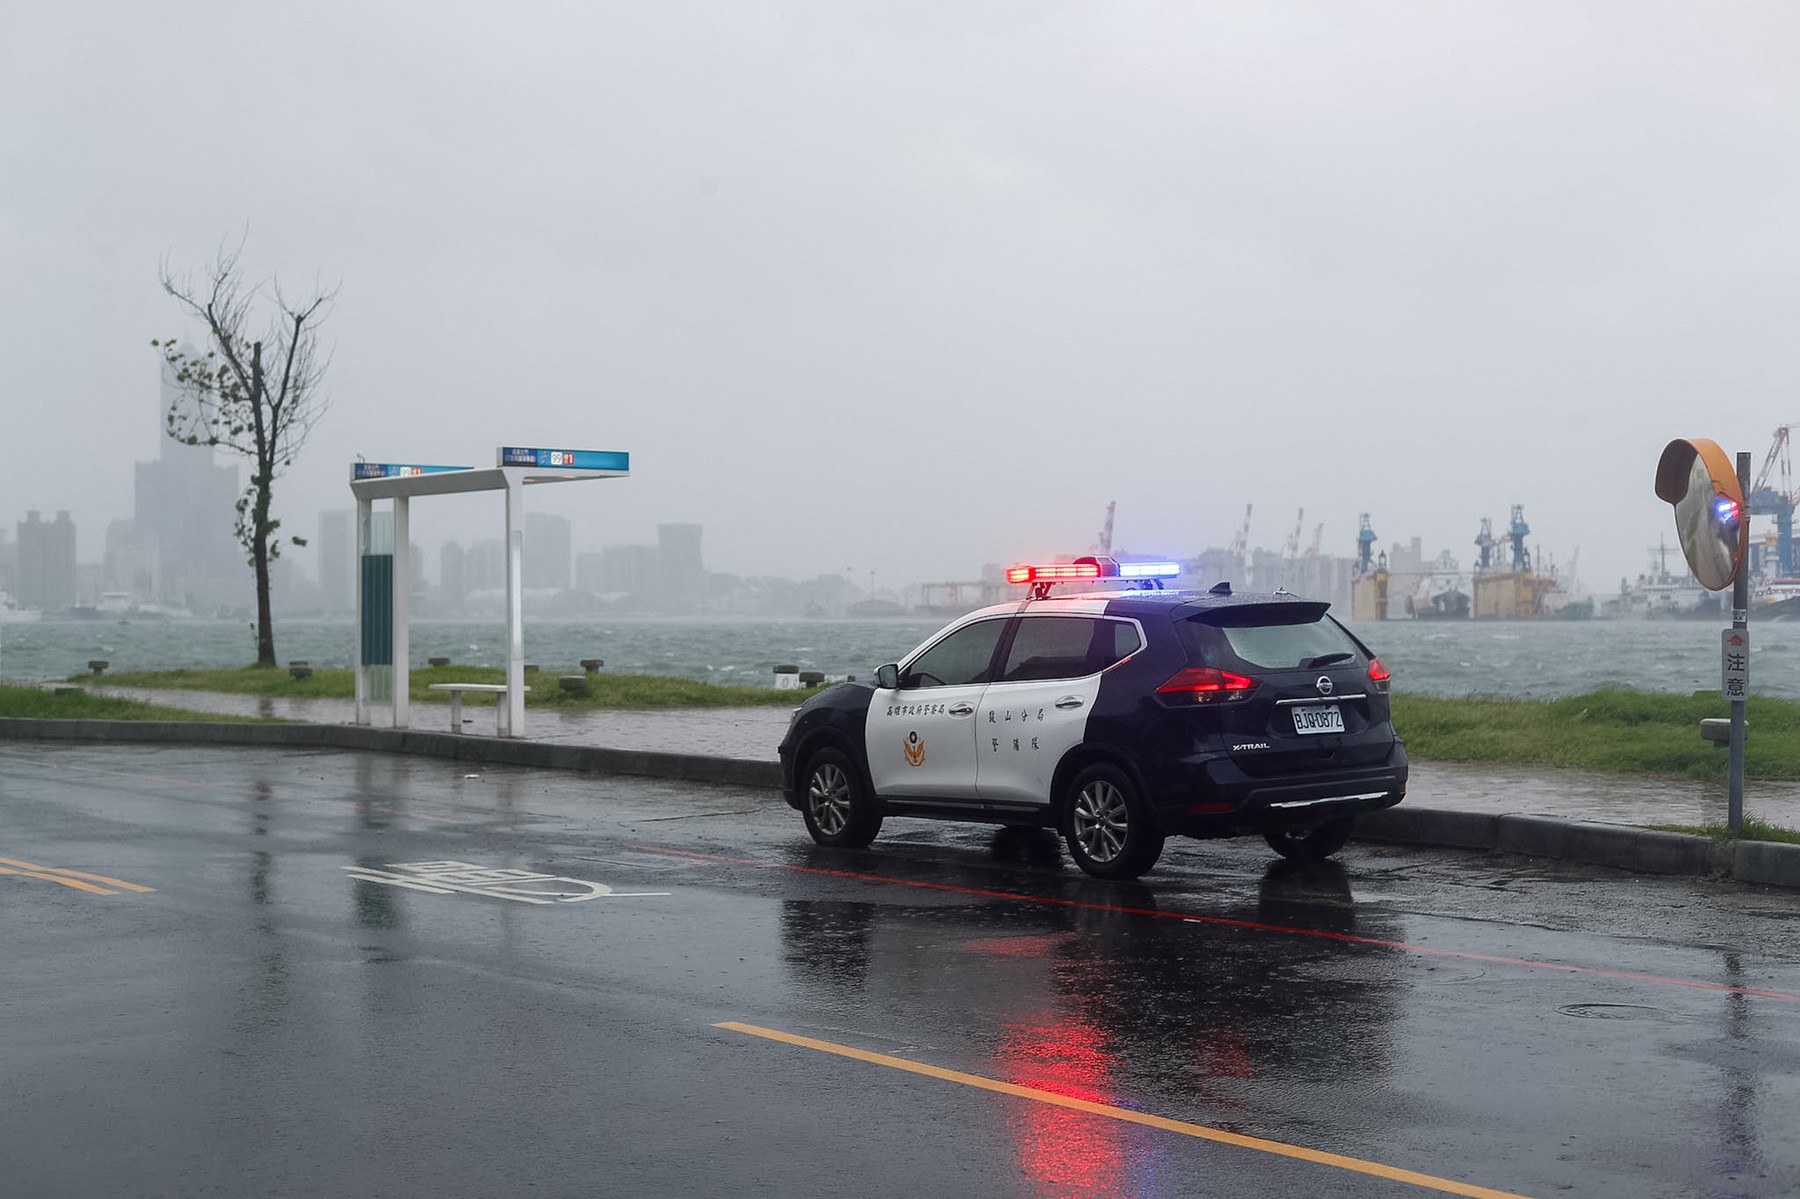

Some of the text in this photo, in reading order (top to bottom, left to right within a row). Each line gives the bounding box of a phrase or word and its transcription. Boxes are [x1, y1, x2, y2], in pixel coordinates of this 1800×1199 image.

[1726, 653, 1745, 696] 注意
[1294, 711, 1342, 730] BJQ-0872
[1232, 742, 1271, 751] X-TRAIL
